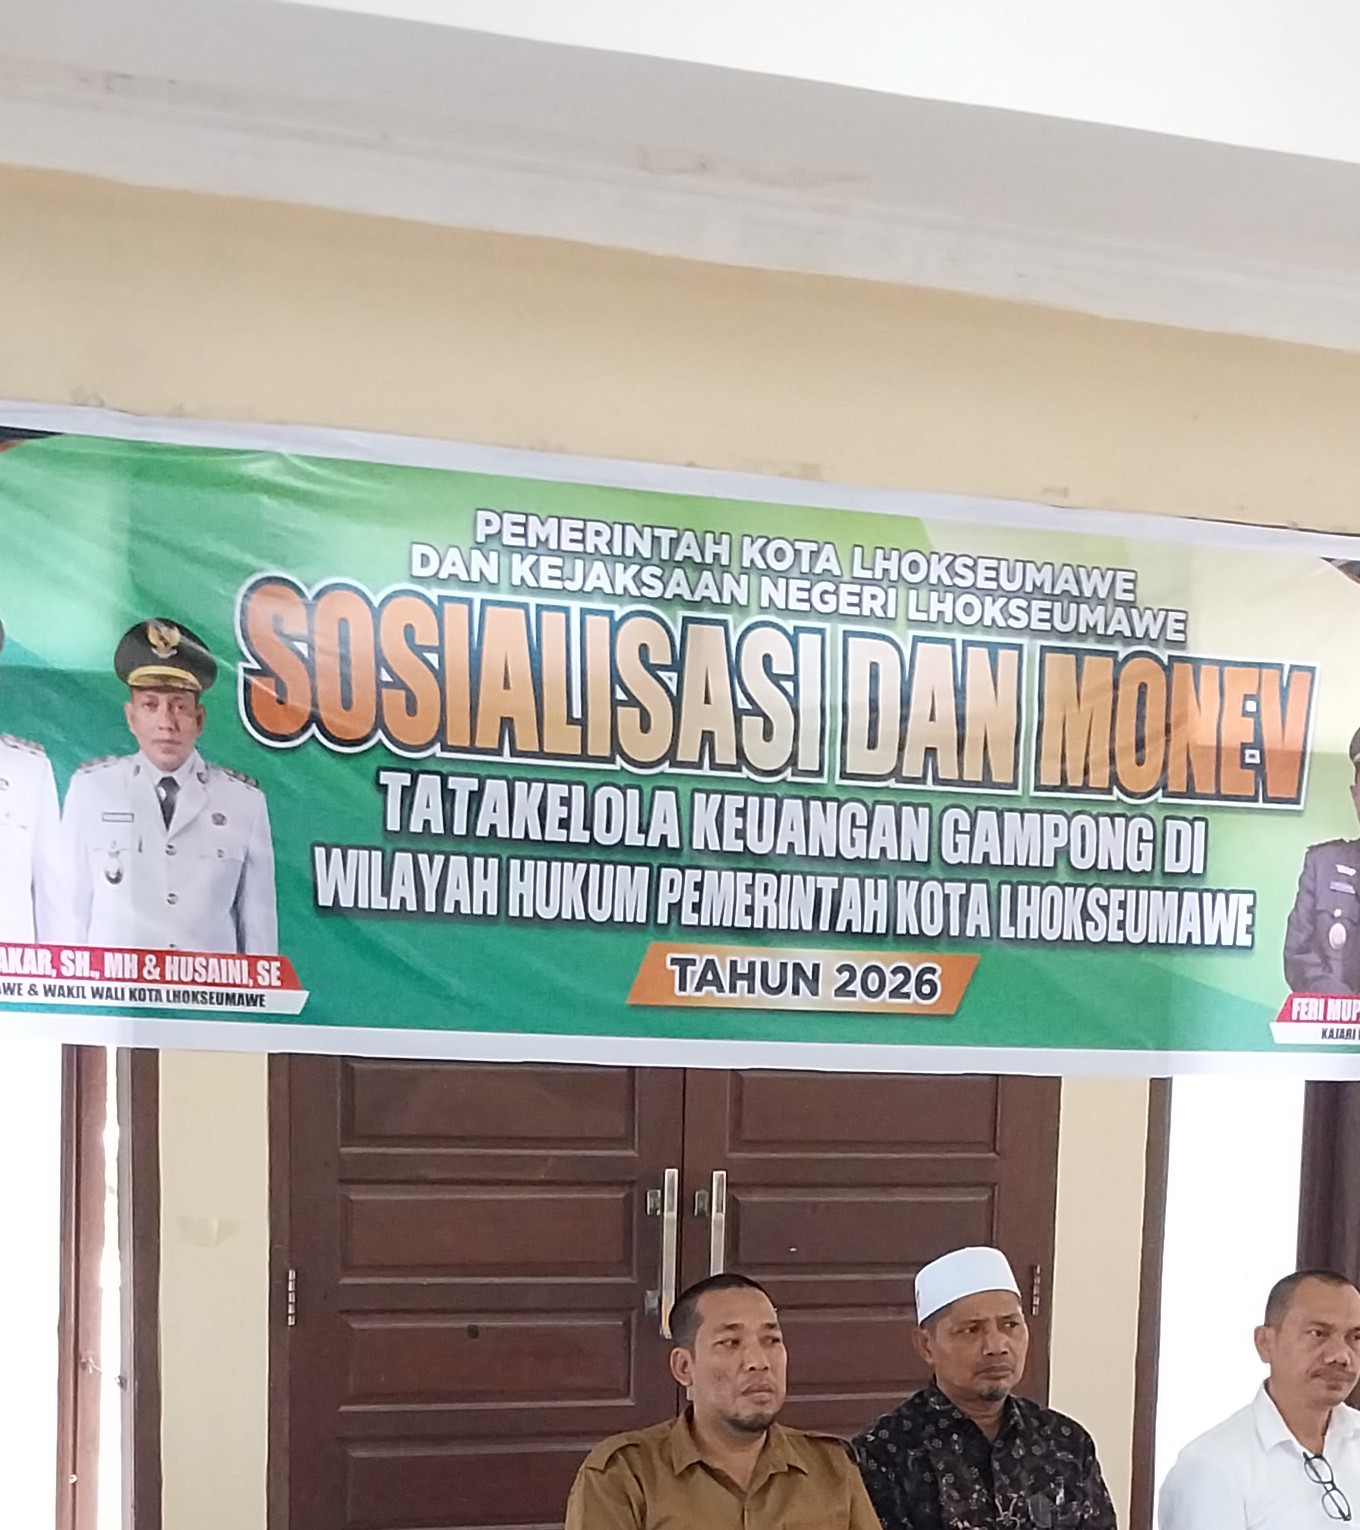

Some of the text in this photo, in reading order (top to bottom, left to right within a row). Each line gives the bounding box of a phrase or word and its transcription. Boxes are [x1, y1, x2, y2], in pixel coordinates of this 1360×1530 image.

[475, 509, 1137, 601] PEMERINTAH KOTA LHOKSEUMAWE
[410, 543, 1189, 642] DAN KEJAKSAAN NEGERI LHOKSEUMAWE
[241, 576, 1316, 805] SOSIALISASI DAN MONEV
[378, 770, 1207, 875] TATAKELOLA KEUANGAN GAMPONG DI
[313, 846, 1256, 948] WILAYAH HUKUM PEMERINTAH KOTA LHOKSEUMAWE
[27, 984, 40, 997] &
[42, 984, 87, 999] WAKIL
[90, 985, 125, 1001] WALI
[128, 987, 163, 1003] KOTA
[166, 989, 266, 1008] LHOKSEUMAWE
[60, 949, 100, 979] SH.,
[103, 952, 138, 979] MH
[142, 954, 161, 981] &
[165, 956, 254, 987] HUSAINI,
[256, 960, 282, 987] SE
[668, 957, 943, 1003] TAHUN 2026
[1291, 997, 1324, 1021] FERI
[1321, 1027, 1356, 1041] KAJARI
